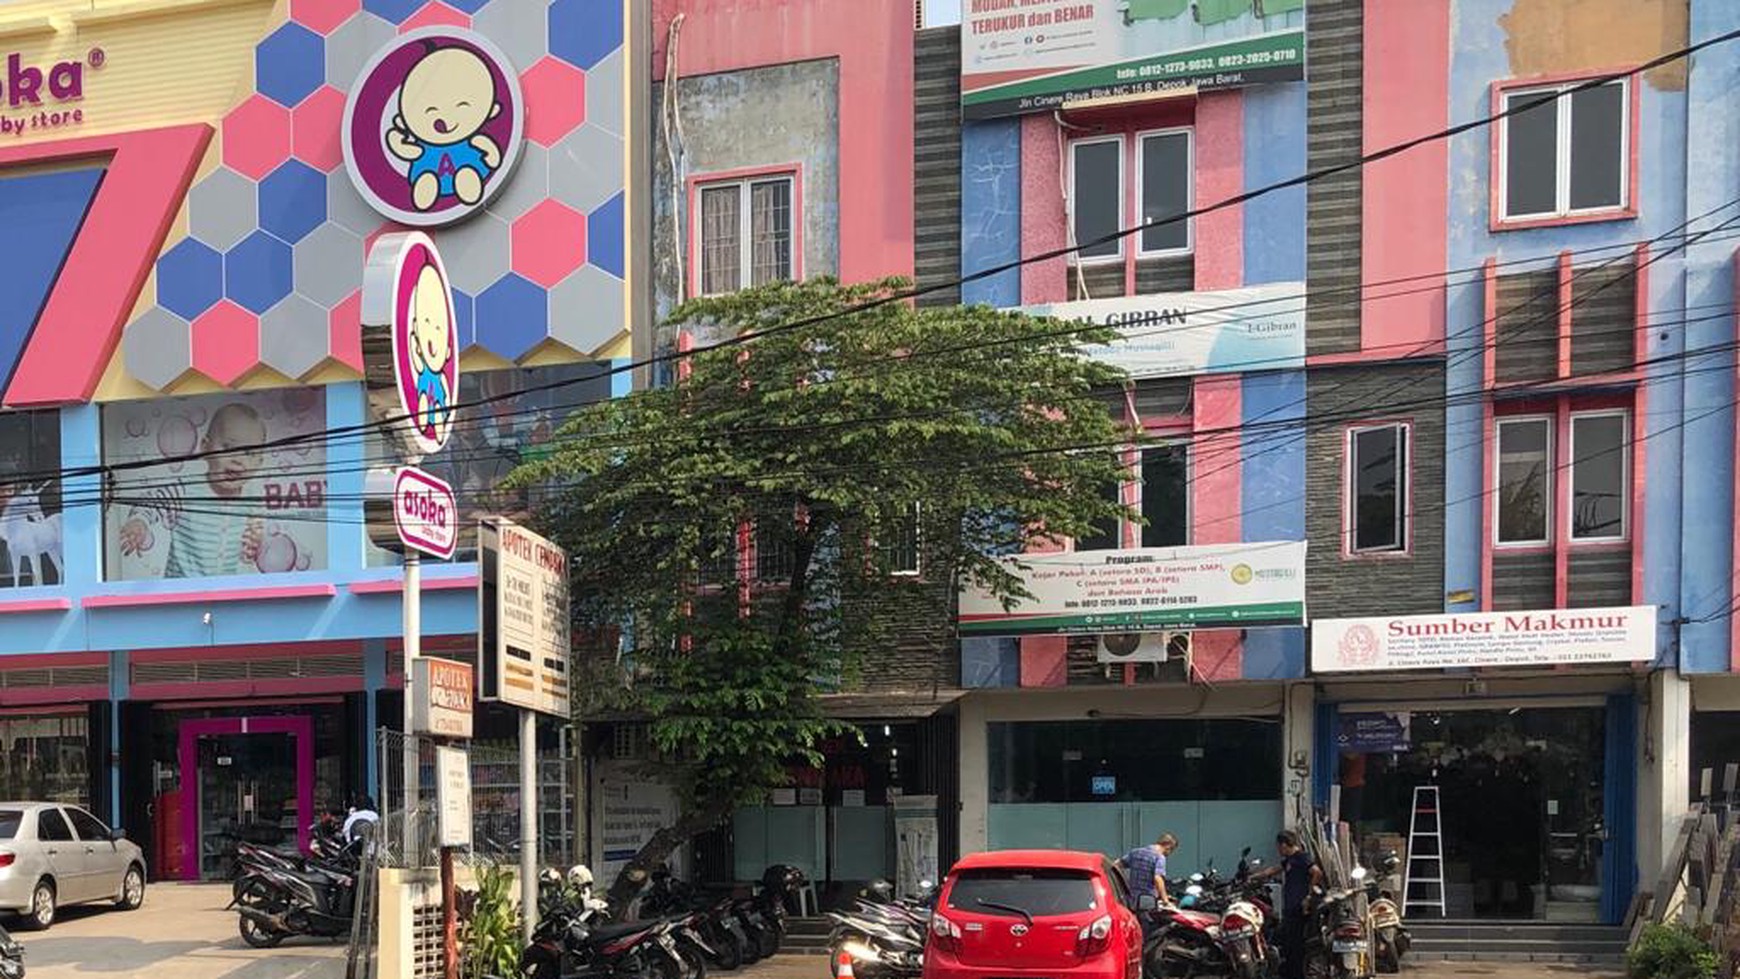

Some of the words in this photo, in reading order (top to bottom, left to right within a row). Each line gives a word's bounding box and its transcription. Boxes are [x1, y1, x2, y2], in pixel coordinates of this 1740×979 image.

[972, 13, 1025, 35] TERUKUR
[1028, 12, 1051, 27] dan
[1055, 4, 1094, 24] BENAR
[0, 53, 82, 106] ka
[32, 109, 82, 128] store
[1106, 306, 1188, 330] GIBRAN
[404, 489, 446, 529] asoka
[502, 528, 532, 562] APOTEK
[1388, 618, 1495, 637] Sumber
[1504, 614, 1628, 633] Makmur
